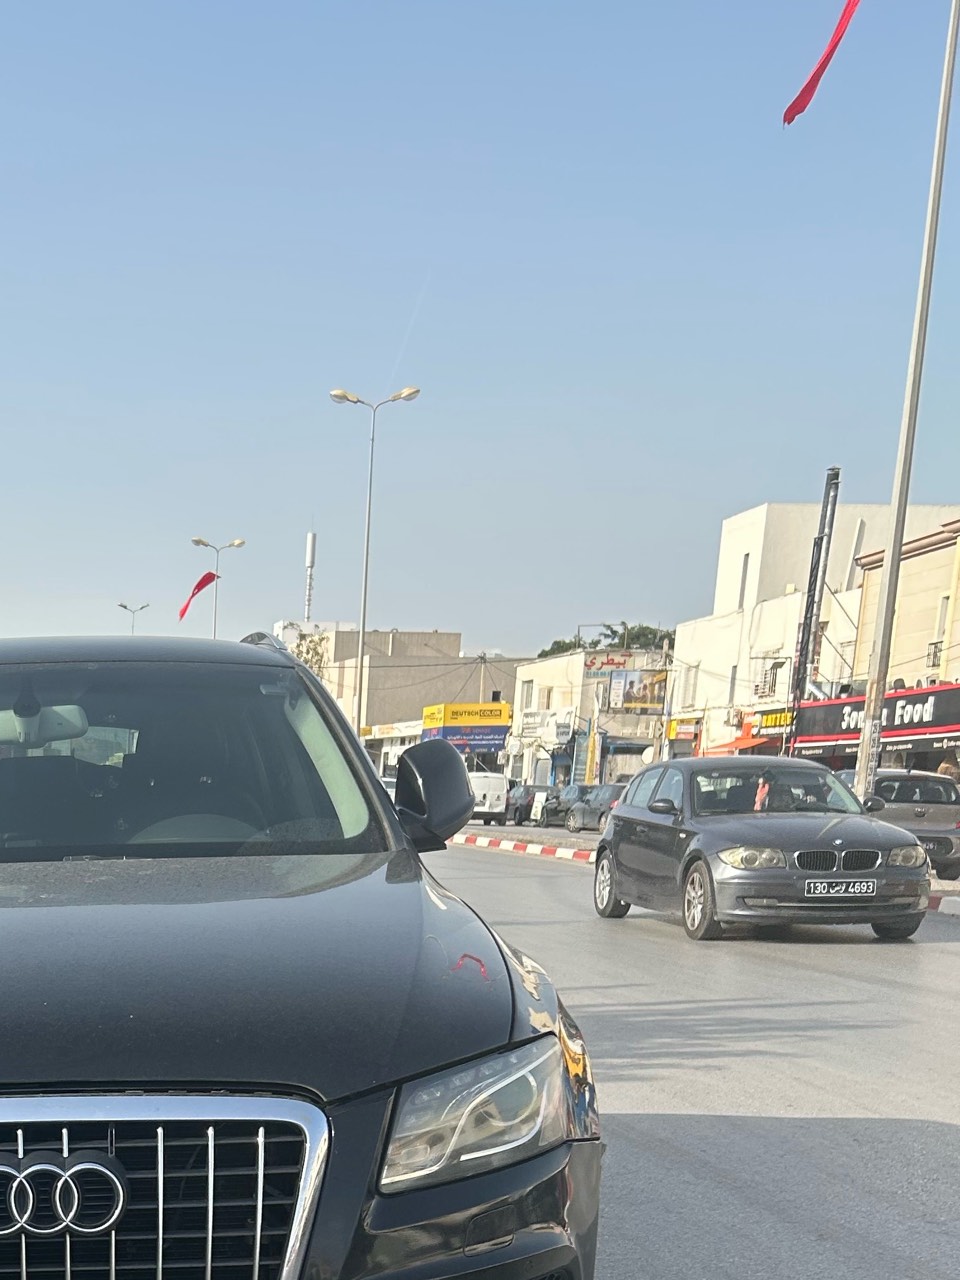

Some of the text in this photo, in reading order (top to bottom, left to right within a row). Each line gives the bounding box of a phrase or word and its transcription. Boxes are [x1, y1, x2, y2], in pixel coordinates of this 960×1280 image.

[584, 652, 627, 671] بيطري
[480, 709, 502, 717] COLOR
[894, 695, 936, 726] Food
[810, 882, 828, 894] 130
[848, 881, 874, 893] 4693
